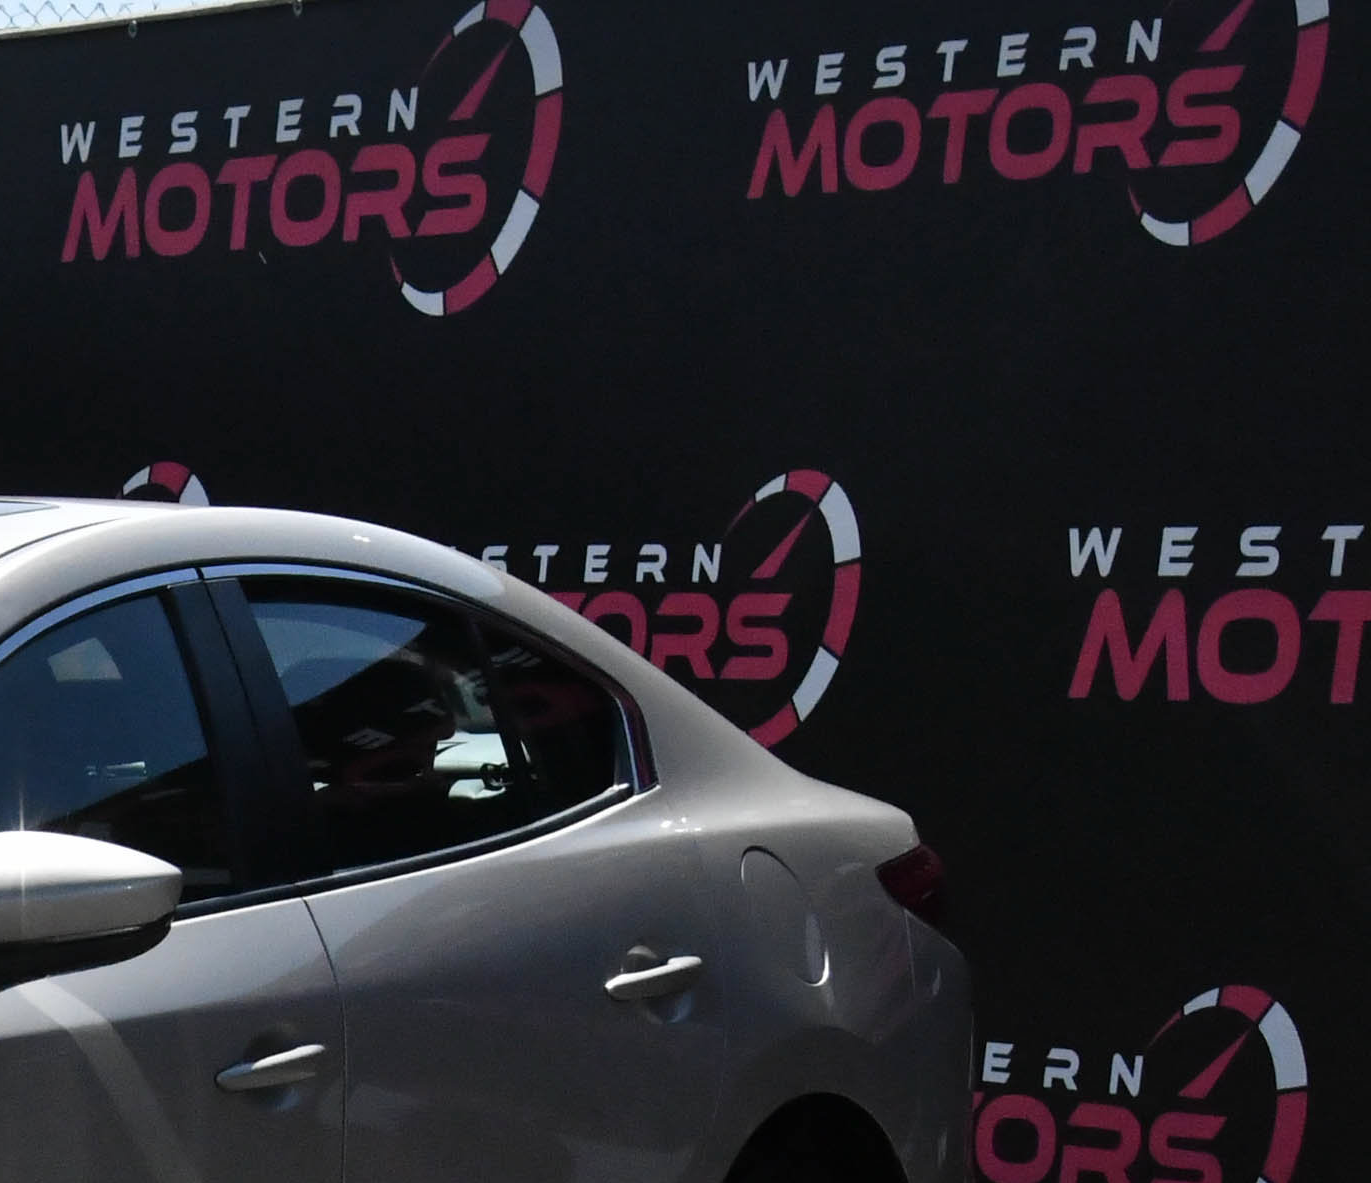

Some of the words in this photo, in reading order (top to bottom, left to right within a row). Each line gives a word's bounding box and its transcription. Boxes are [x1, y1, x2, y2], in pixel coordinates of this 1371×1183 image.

[747, 18, 1162, 102] WESTERN
[60, 86, 419, 165] WESTERN
[747, 64, 1250, 202] MOTORS
[61, 132, 495, 263] MOTORS
[1068, 524, 1365, 578] WEST
[1068, 588, 1371, 704] MOT
[982, 1041, 1144, 1097] ERN
